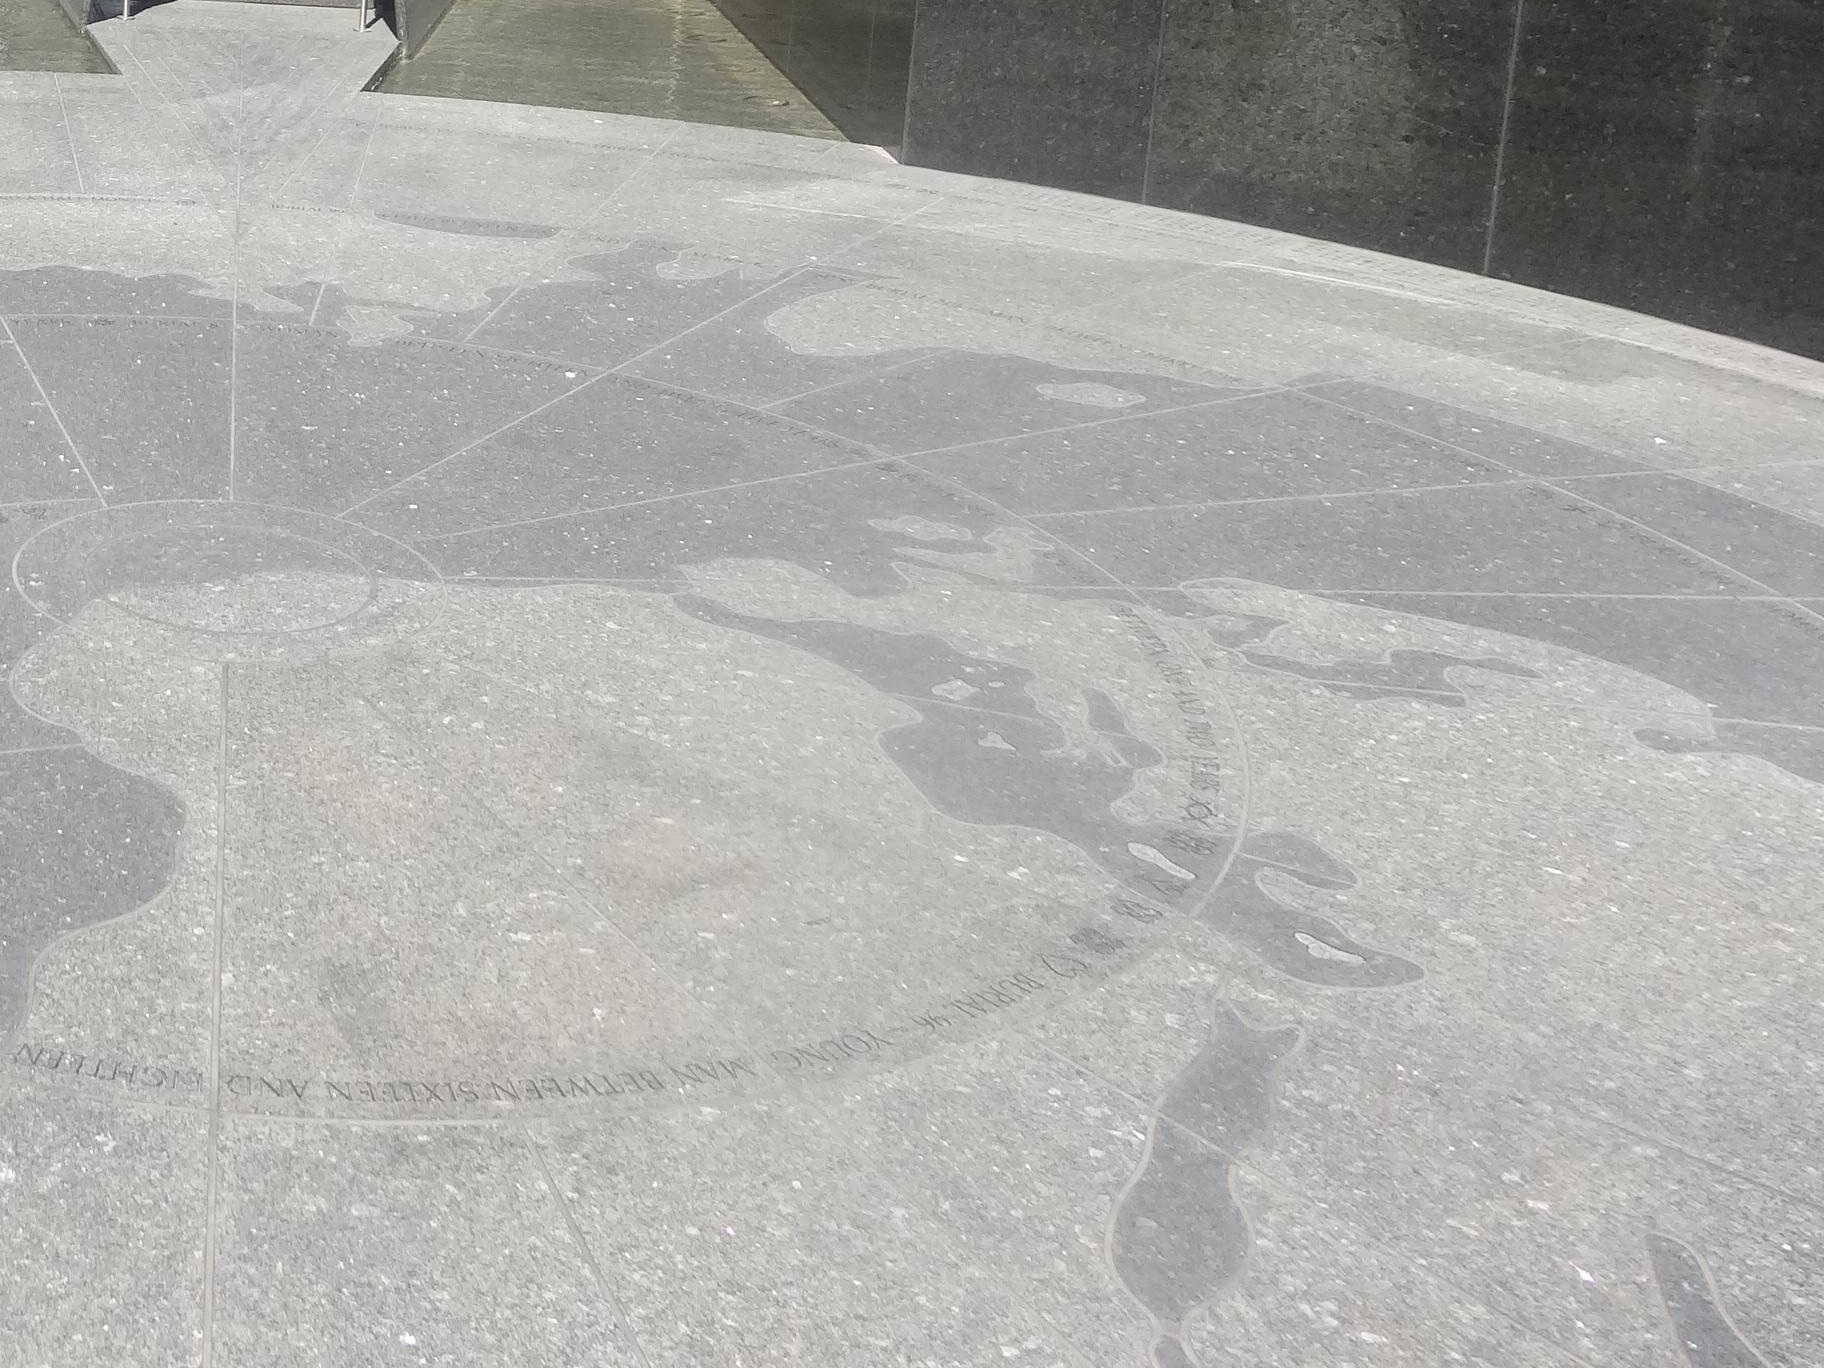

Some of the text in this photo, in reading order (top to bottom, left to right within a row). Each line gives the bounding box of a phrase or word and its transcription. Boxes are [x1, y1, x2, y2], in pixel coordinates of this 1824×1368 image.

[948, 973, 1045, 1021] BURIAL
[12, 1043, 204, 1087] EIGHTEEN
[769, 1031, 894, 1069] YOUNG
[487, 1070, 665, 1100] BETWEEN
[669, 1057, 756, 1086] MAN
[226, 1076, 310, 1100] AND
[324, 1081, 479, 1103] SIXTEEN
